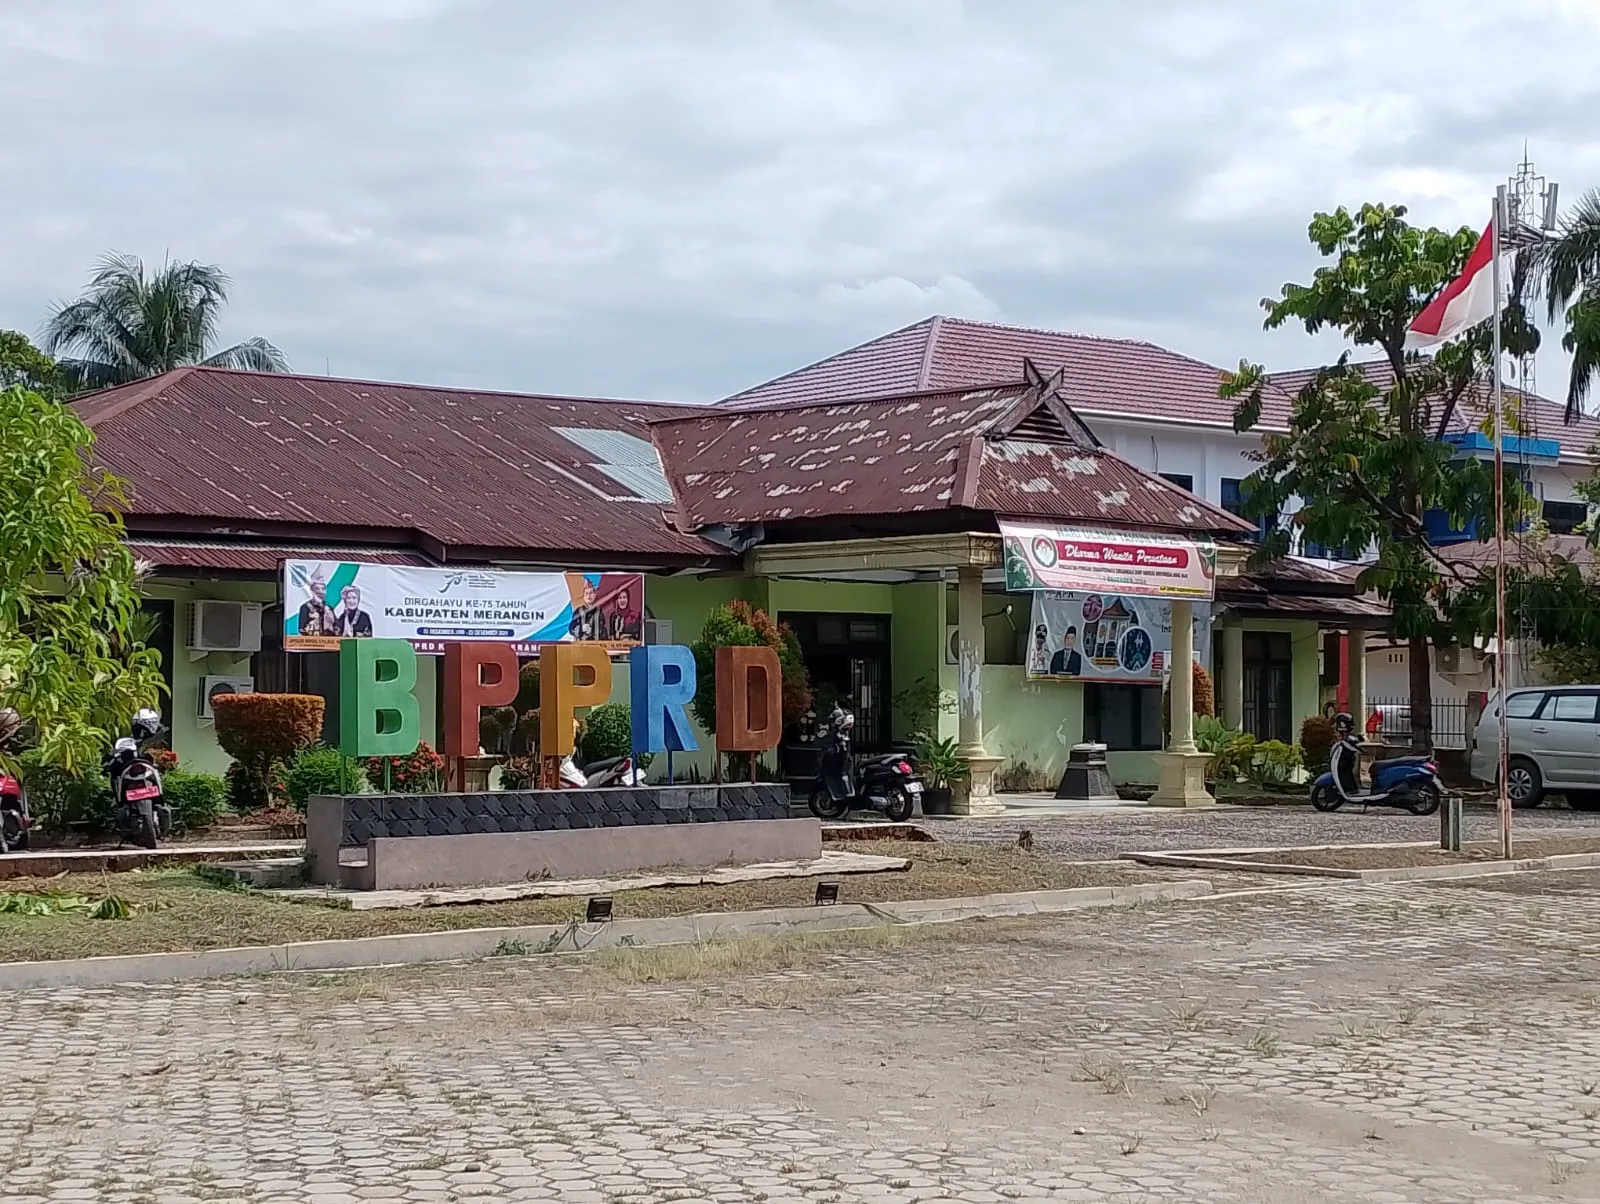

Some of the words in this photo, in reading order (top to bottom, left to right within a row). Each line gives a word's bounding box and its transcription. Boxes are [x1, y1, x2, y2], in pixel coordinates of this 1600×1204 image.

[1064, 544, 1100, 560] Dharma
[1102, 547, 1134, 562] Wanita
[1136, 549, 1178, 564] Persatuan
[404, 597, 463, 607] DIRGAHAYU
[465, 599, 493, 608] KE-75
[495, 600, 527, 609] TAHUN
[384, 607, 469, 619] KABUPATEN
[473, 609, 545, 621] MERANGIN
[339, 638, 783, 758] BPPRD
